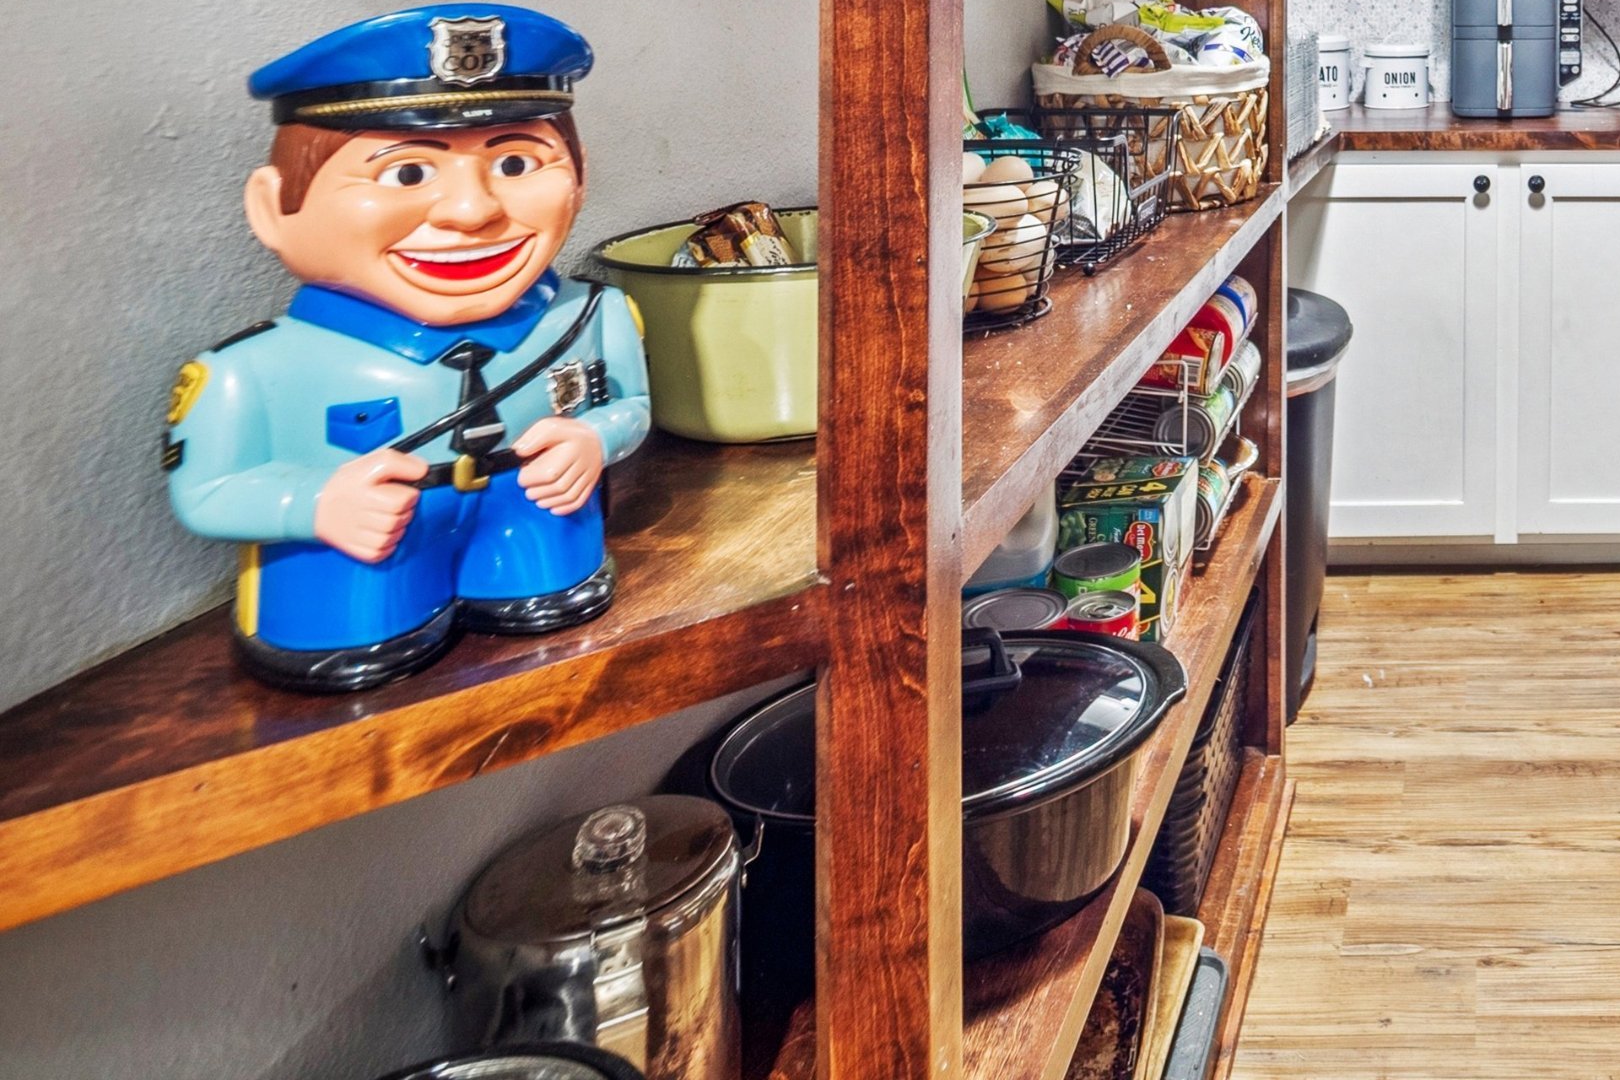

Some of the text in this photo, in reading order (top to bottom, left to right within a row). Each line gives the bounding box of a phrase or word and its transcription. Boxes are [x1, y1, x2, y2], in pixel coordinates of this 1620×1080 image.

[443, 53, 496, 72] COP
[1319, 66, 1338, 81] ATO
[1384, 72, 1416, 85] ONION
[1139, 481, 1167, 493] 4
[1137, 524, 1145, 537] Del
